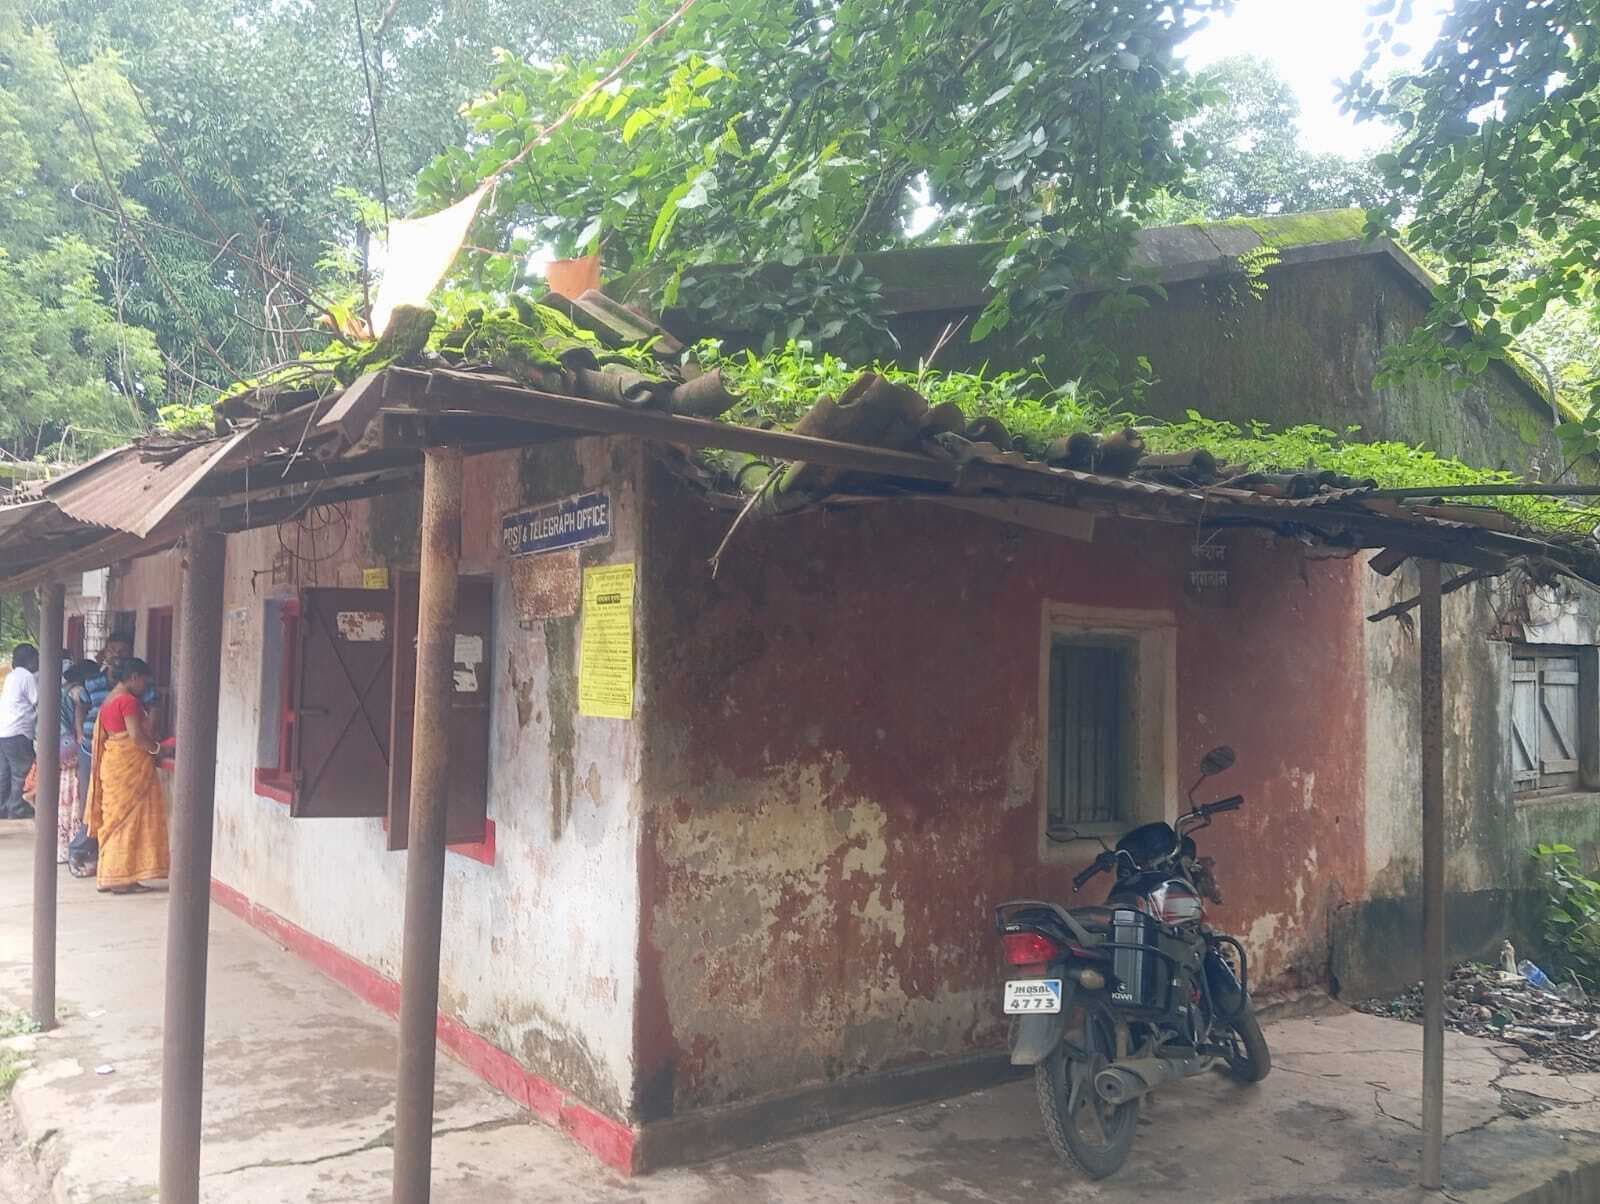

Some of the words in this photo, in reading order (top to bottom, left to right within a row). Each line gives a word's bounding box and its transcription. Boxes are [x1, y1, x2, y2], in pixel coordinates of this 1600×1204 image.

[503, 525, 522, 545] POST
[529, 511, 576, 542] TELEGRAPH
[577, 503, 607, 530] OFFICE
[1010, 998, 1055, 1009] 4773
